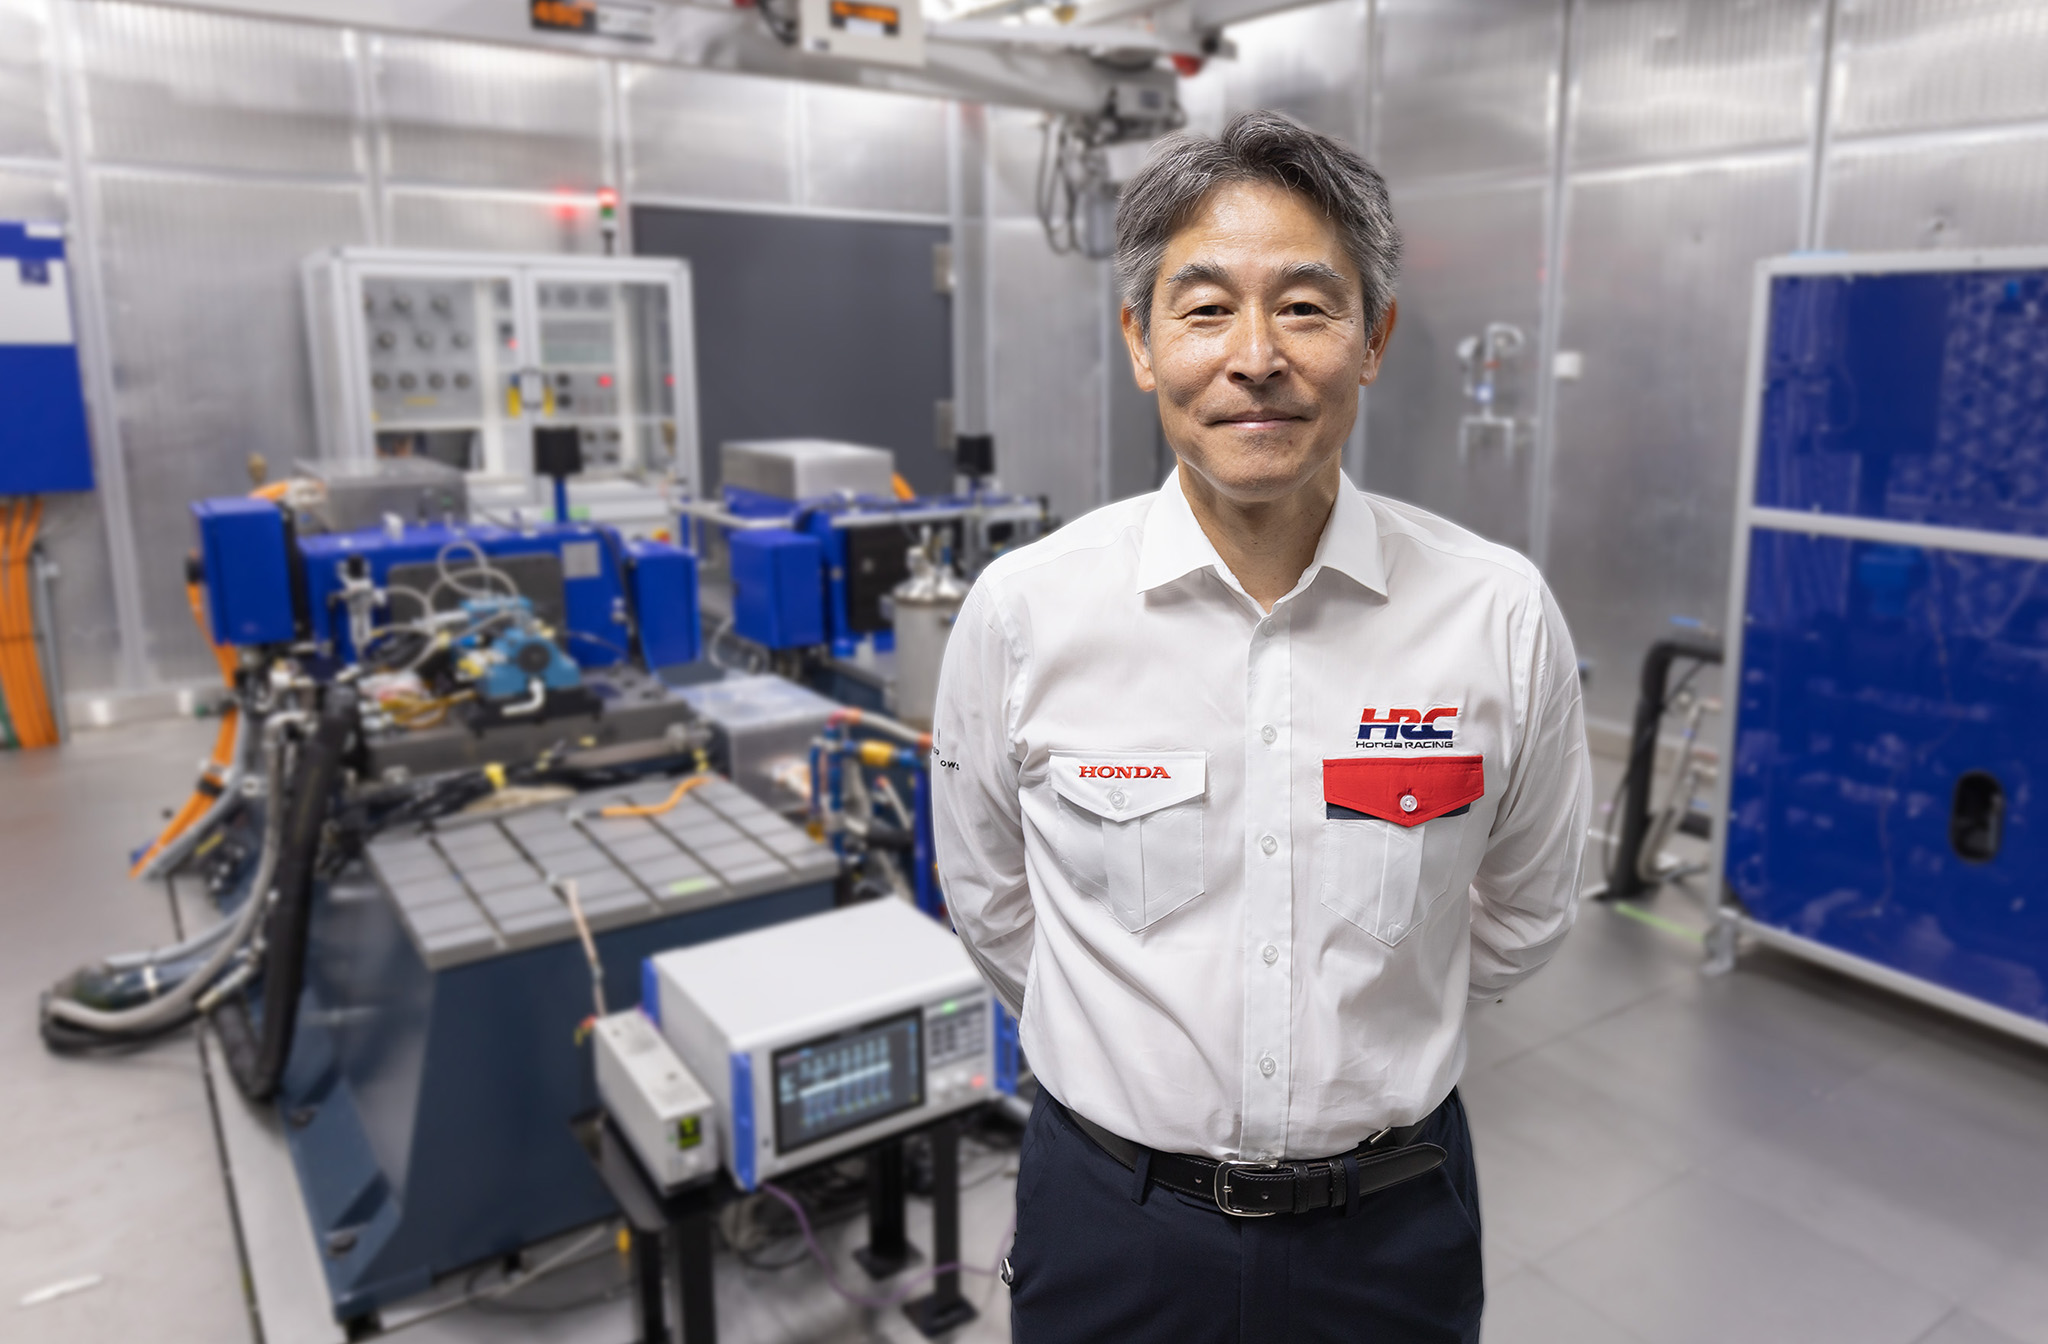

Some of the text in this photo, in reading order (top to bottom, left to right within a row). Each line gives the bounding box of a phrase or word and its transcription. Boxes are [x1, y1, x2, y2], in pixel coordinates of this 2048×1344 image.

[1357, 707, 1459, 740] HRC
[1355, 740, 1454, 749] Honda RACING
[1079, 765, 1171, 779] HONDA
